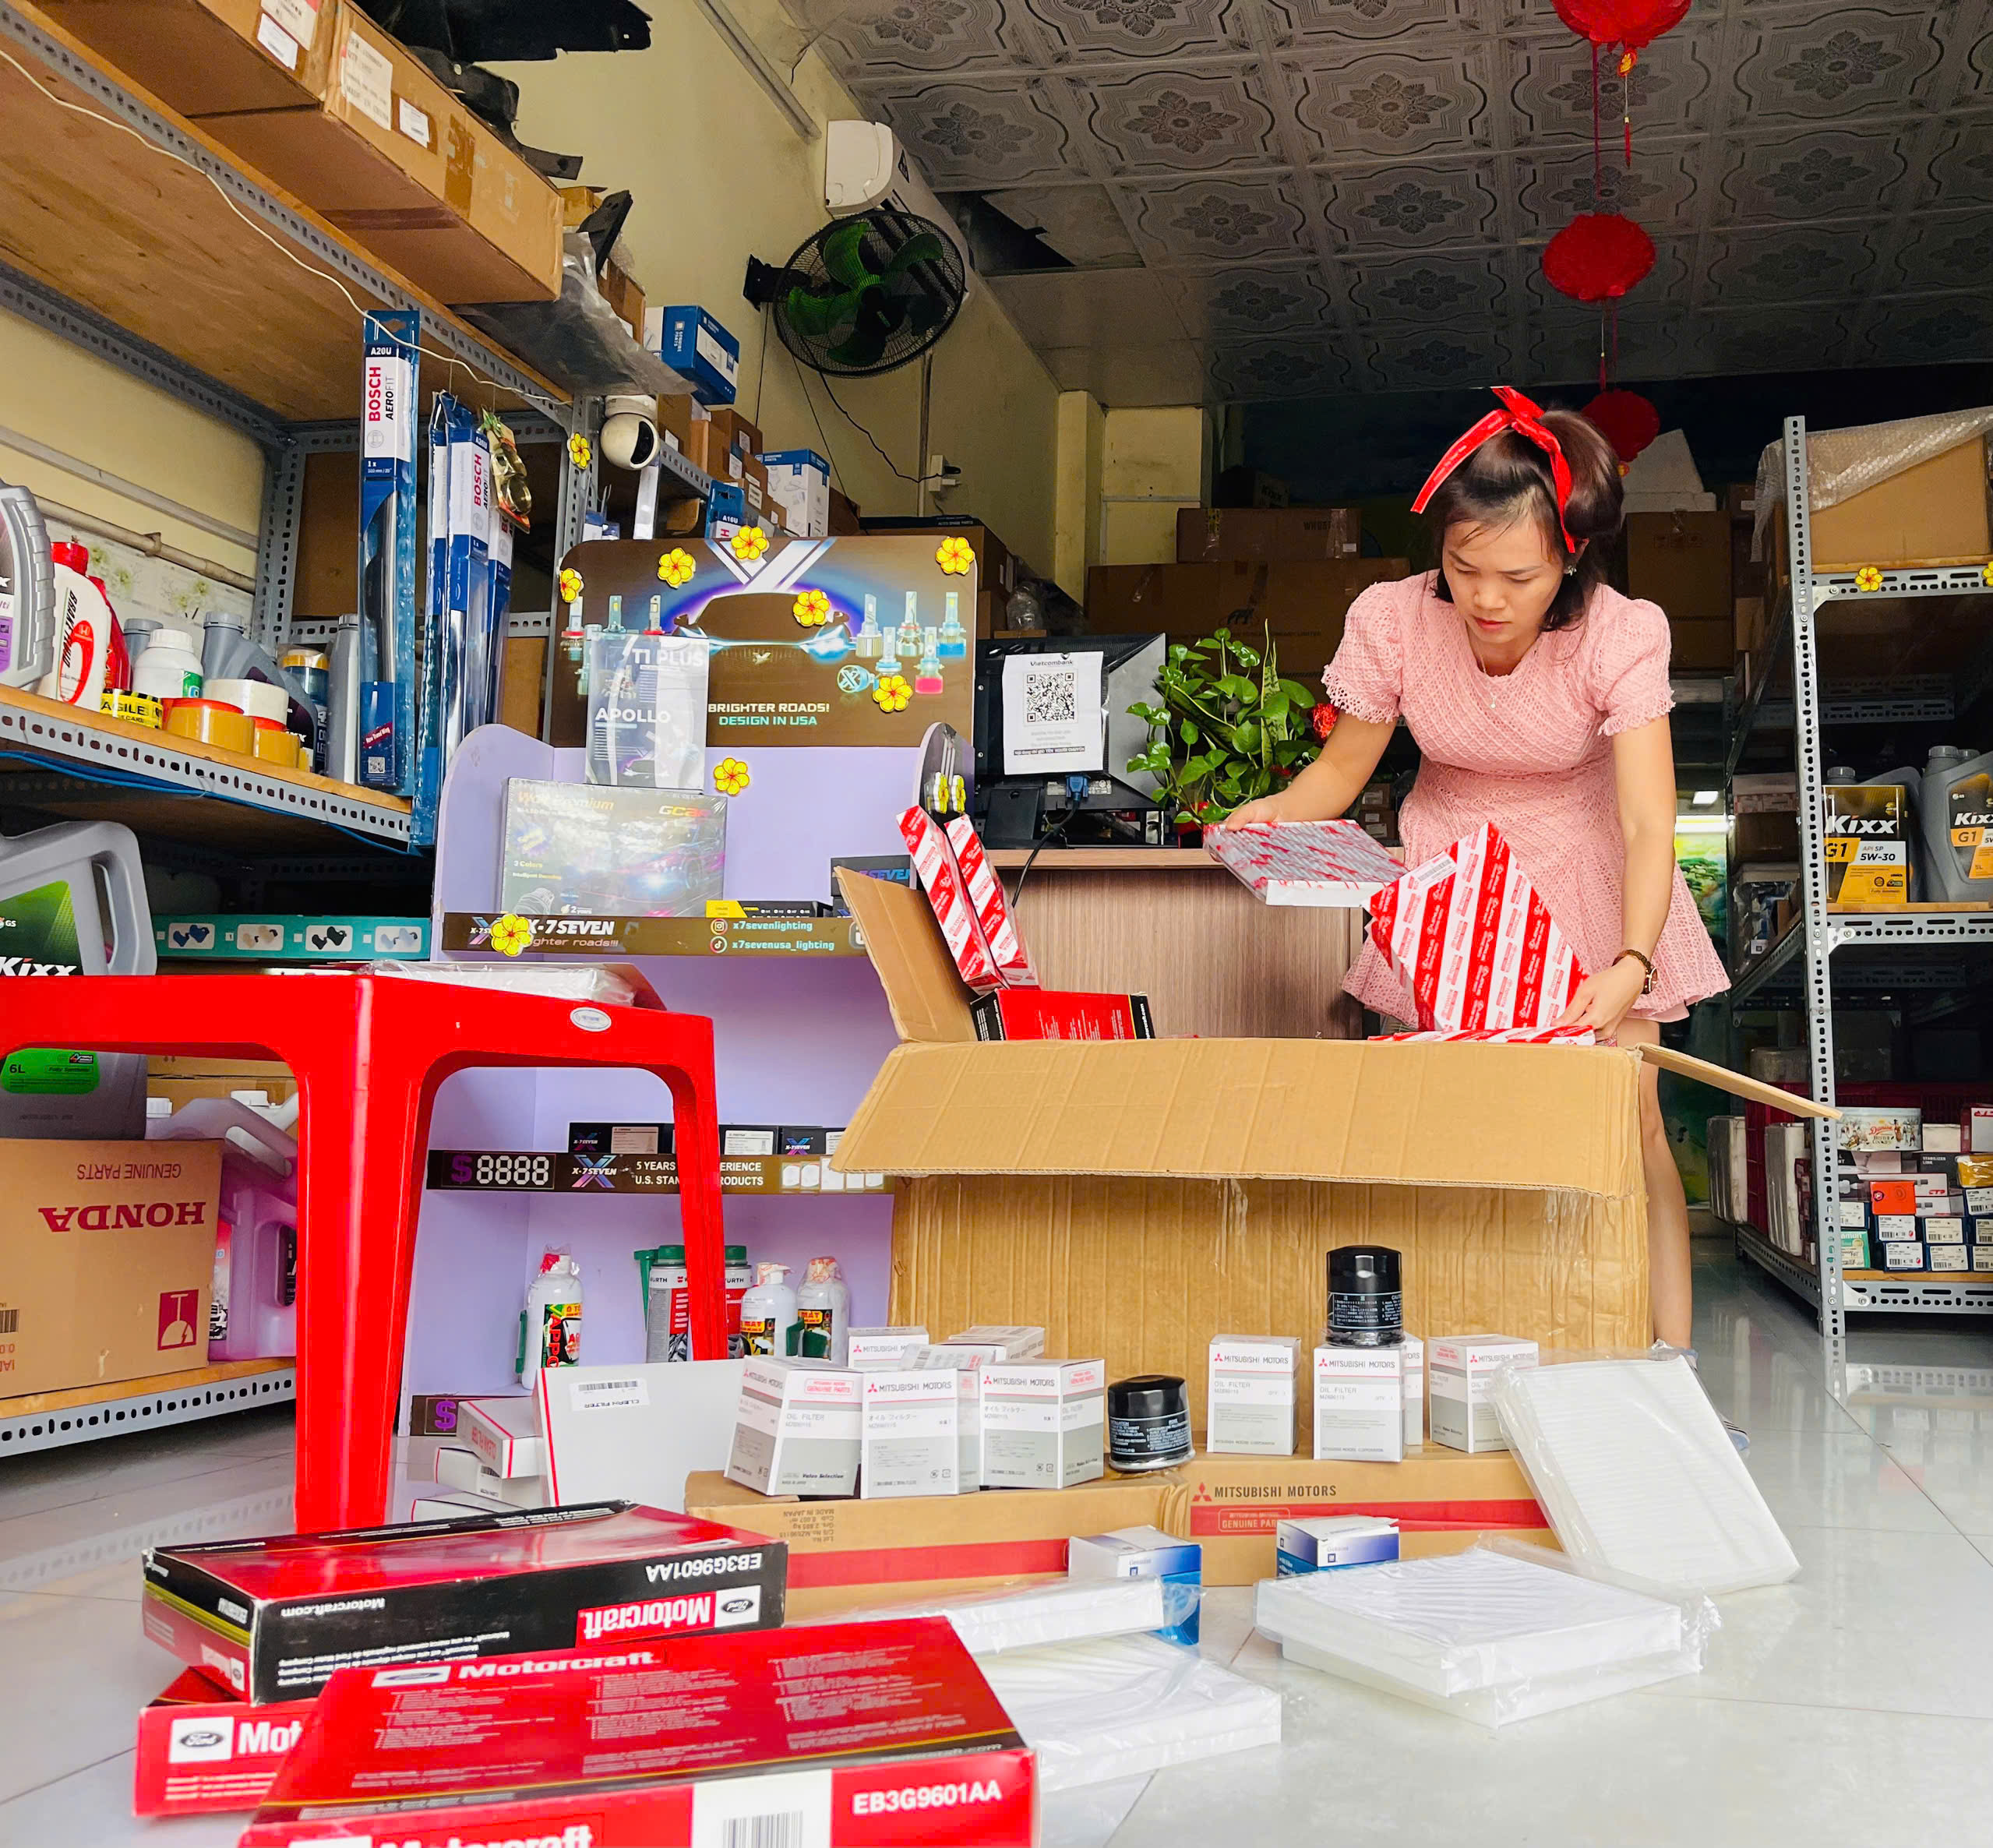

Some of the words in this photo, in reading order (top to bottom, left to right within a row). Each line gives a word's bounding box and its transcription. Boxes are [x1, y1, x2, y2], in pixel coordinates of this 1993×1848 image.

[370, 347, 392, 355] A20U
[369, 366, 381, 421] BOSCH
[386, 376, 394, 420] AEROFIT
[474, 453, 482, 506] BOSCH
[722, 515, 739, 524] A16U
[657, 650, 705, 667] PLUS
[101, 700, 146, 716] AGILE
[595, 707, 671, 724] APOLLO
[708, 704, 775, 713] BRIGHTER
[779, 704, 830, 713] ROADS!
[719, 716, 769, 725] DESIGN
[773, 717, 787, 725] IN
[790, 716, 817, 725] USA
[1824, 815, 1898, 834] Kixx
[1958, 831, 1977, 842] G1
[1824, 843, 1847, 858] G1
[733, 921, 813, 931] x7sevenlighting
[533, 938, 569, 947] ghter
[573, 938, 619, 947] roads!!!
[732, 940, 834, 951] x7sevenusa_lighting
[9, 1063, 26, 1074] 6L
[77, 1163, 120, 1180] PARTS
[124, 1163, 181, 1179] GENUINE
[636, 1161, 642, 1170] 5
[644, 1161, 676, 1170] YEARS
[721, 1162, 761, 1171] ERIENCE
[635, 1176, 654, 1184] U.S.
[721, 1176, 764, 1185] RODUCTS
[38, 1201, 206, 1233] HONDA
[879, 1384, 919, 1392] MITSUBISHI
[922, 1381, 952, 1391] MOTORS
[1214, 1486, 1282, 1498] MITSUBISHI
[1287, 1485, 1337, 1497] MOTORS
[1222, 1520, 1258, 1529] GENUINE
[1261, 1519, 1276, 1528] PAR
[645, 1553, 763, 1582] EB3G9601AA
[281, 1597, 386, 1617] Motorcraft.com
[584, 1596, 711, 1640] Motorcraft
[459, 1650, 654, 1679] Motorcraft
[852, 1779, 1002, 1815] EB3G9601AA
